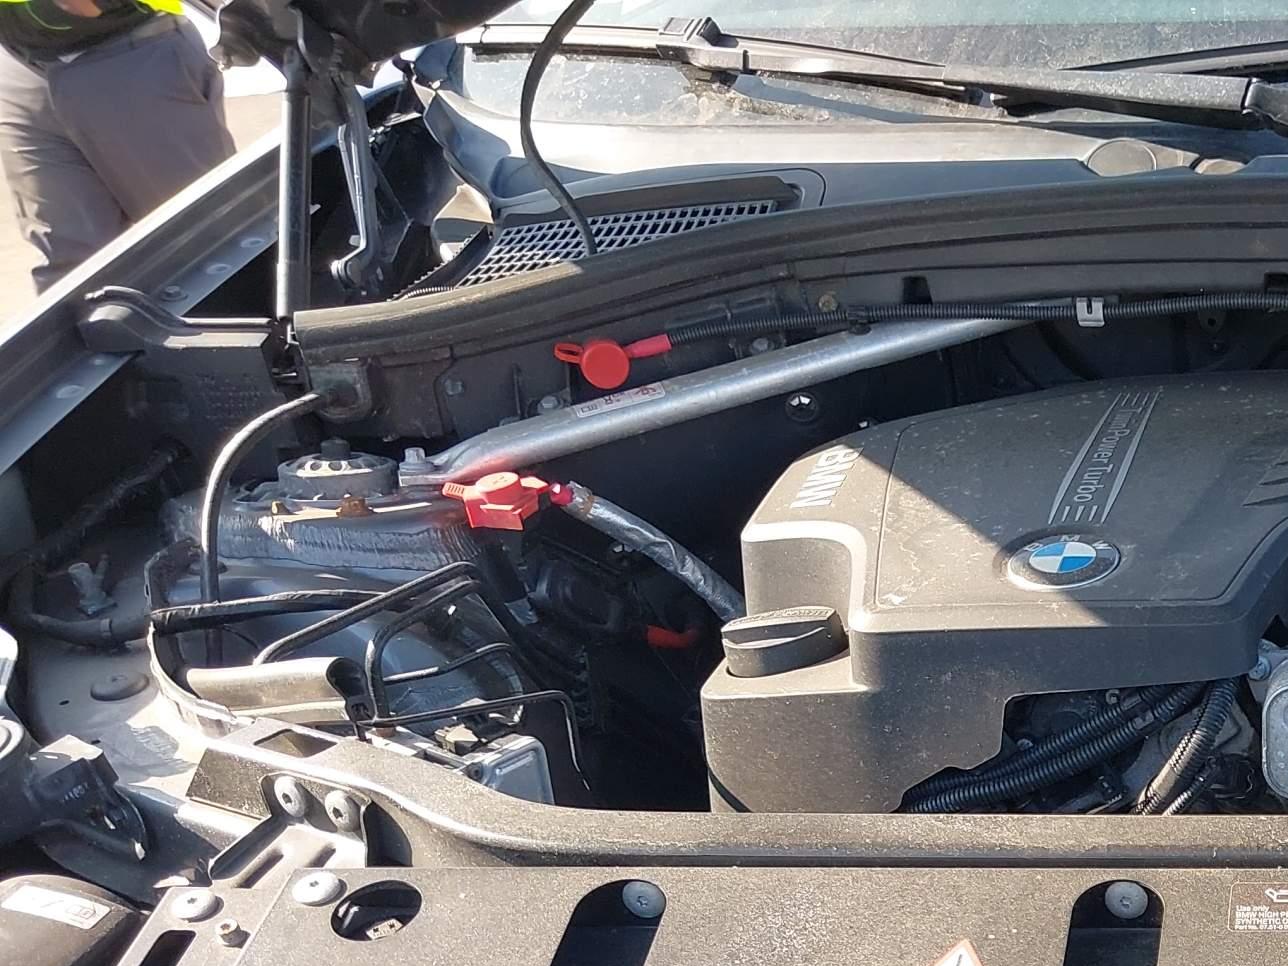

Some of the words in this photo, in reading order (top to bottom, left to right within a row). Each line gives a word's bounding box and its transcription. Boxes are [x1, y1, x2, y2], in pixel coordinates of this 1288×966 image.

[790, 446, 862, 508] BMW
[1073, 463, 1114, 502] Turbo
[1252, 904, 1270, 913] only
